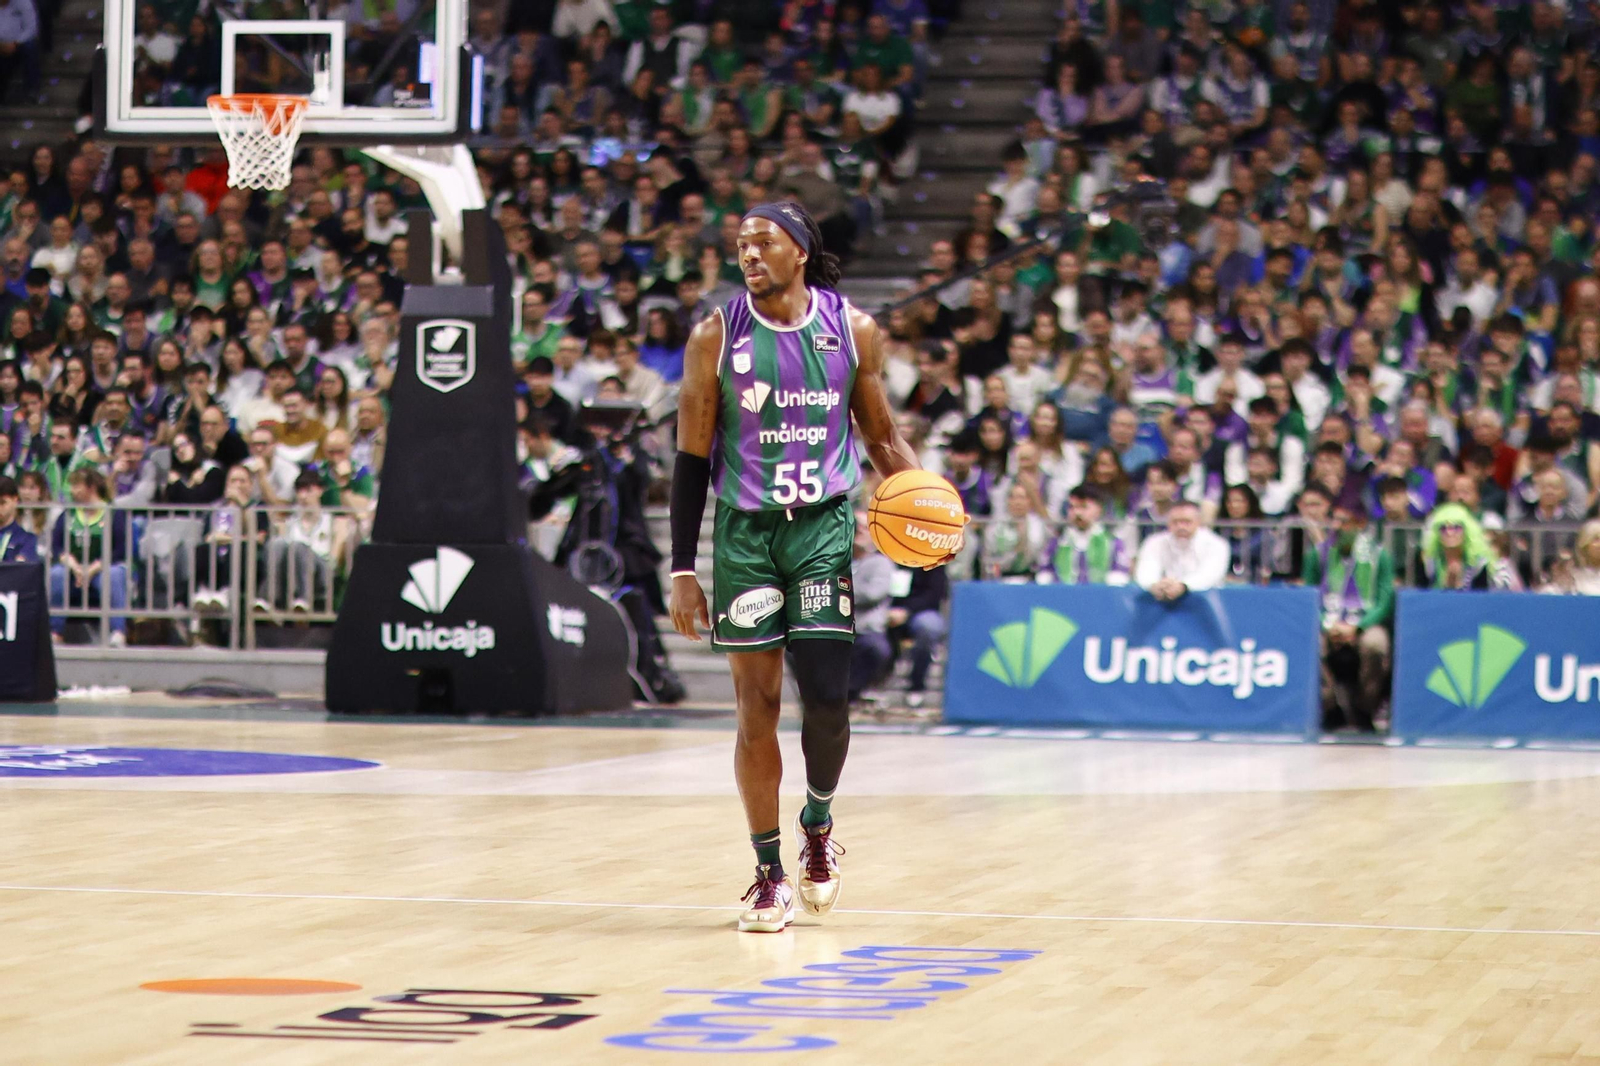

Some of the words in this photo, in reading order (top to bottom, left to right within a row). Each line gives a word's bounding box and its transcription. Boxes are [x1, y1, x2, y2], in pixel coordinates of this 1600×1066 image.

[775, 388, 840, 411] Unicaja
[772, 461, 824, 504] 55
[905, 523, 964, 554] Wilson
[800, 593, 832, 612] laga
[804, 579, 832, 597] má
[733, 591, 783, 623] famadesa
[381, 620, 496, 657] Unicaja
[1083, 637, 1288, 700] Unicaja
[1535, 653, 1600, 703] Un
[602, 945, 1044, 1053] endesa
